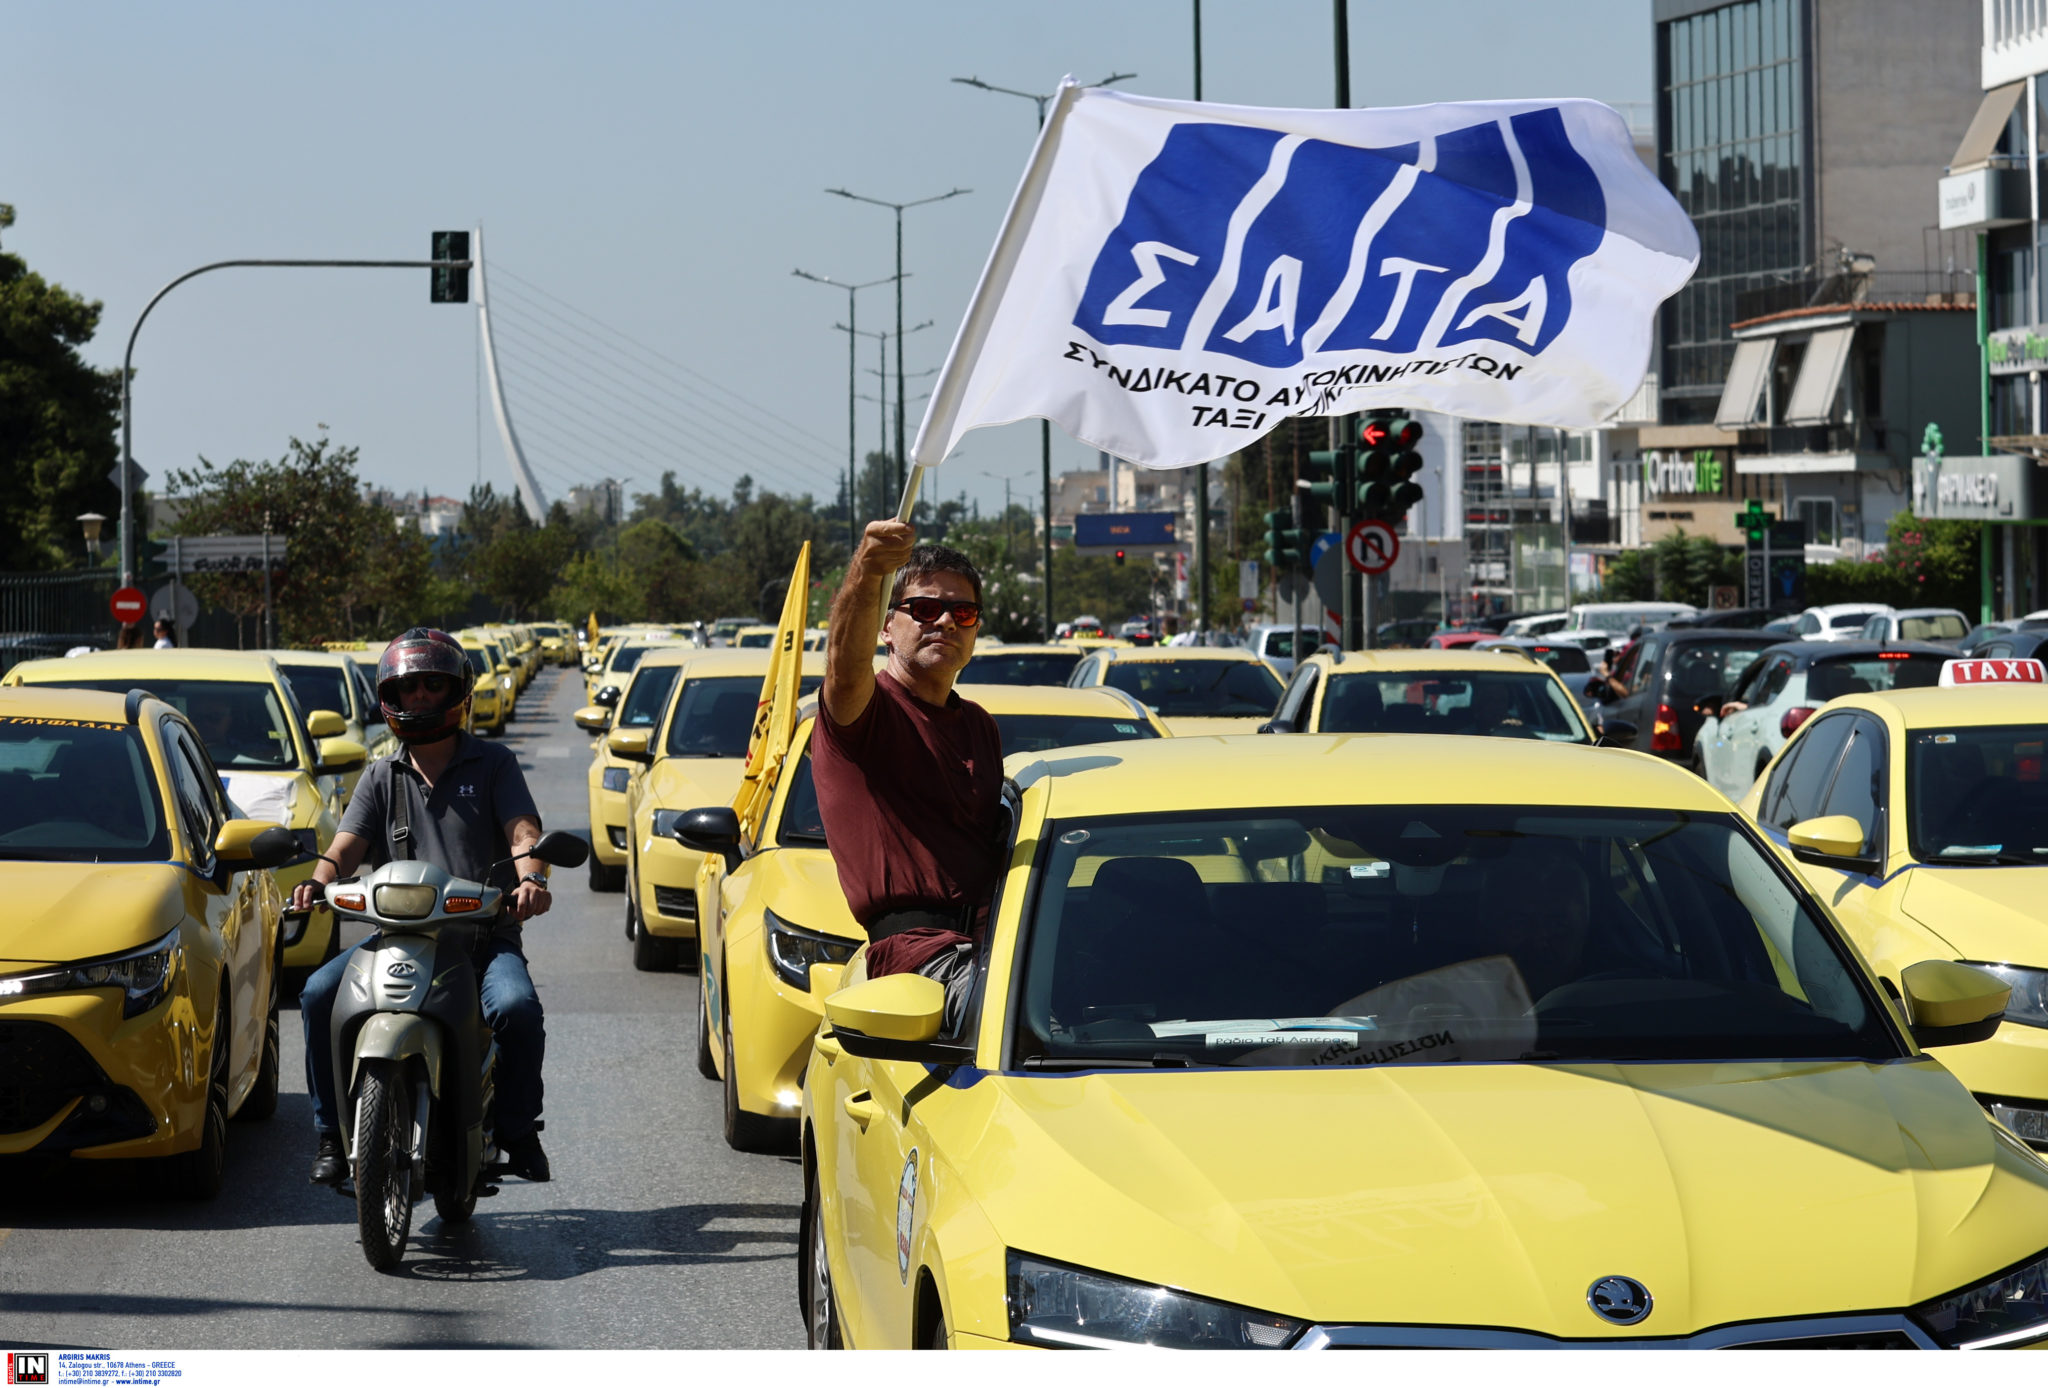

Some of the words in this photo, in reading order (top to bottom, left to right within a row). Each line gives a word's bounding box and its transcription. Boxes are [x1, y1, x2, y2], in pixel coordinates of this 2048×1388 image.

[1063, 341, 1260, 402] ΣΥΝΔΙΚΑΤΟ
[1191, 406, 1266, 430] ΤΑΞΙ
[1958, 661, 2036, 681] TAXI
